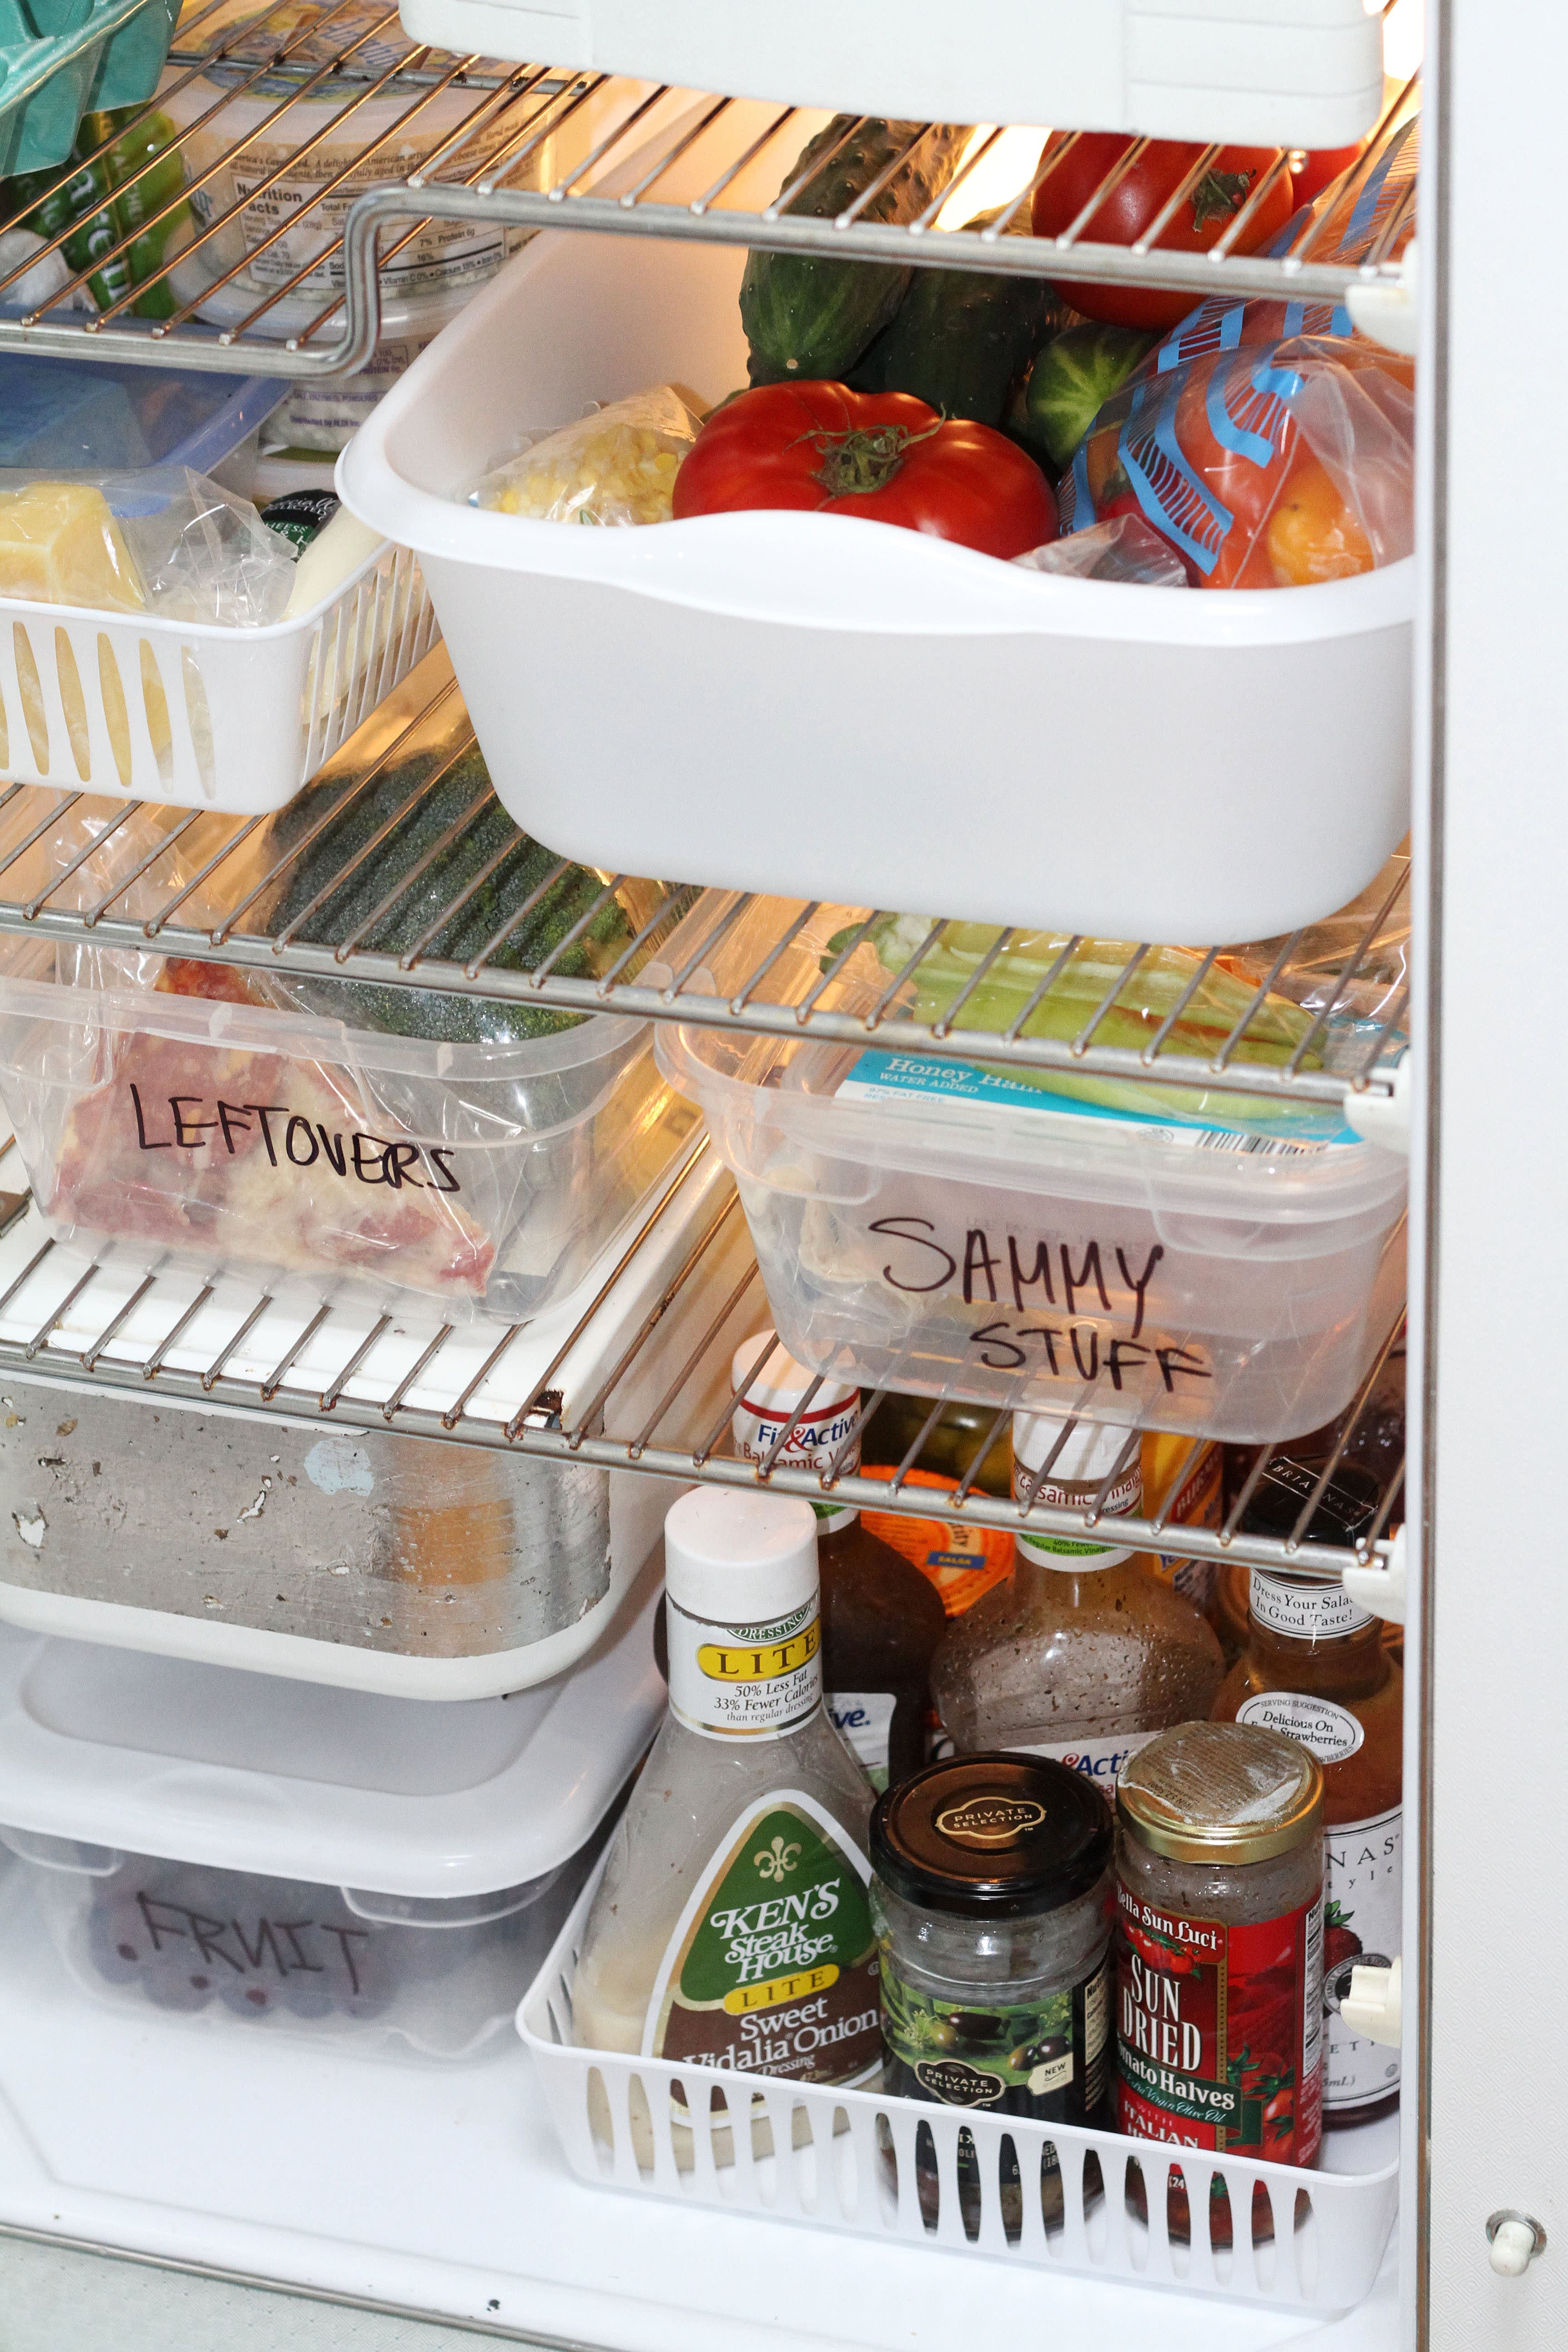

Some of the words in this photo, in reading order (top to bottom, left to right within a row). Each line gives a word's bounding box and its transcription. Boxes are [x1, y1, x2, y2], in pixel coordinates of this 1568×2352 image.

[247, 202, 279, 215] acts
[880, 1072, 926, 1086] WATER
[929, 1079, 979, 1094] ADDED
[885, 1058, 973, 1083] Honey
[130, 1083, 461, 1192] LEFTOVERS
[868, 1217, 1164, 1338] SAMMY
[969, 1322, 1212, 1392] STUFF
[1102, 1498, 1129, 1514] ressing
[1253, 1577, 1282, 1604] Dress
[1284, 1594, 1317, 1610] Your
[1321, 1595, 1353, 1609] Sala
[738, 1611, 804, 1640] DRESSING
[1256, 1596, 1265, 1613] In
[1269, 1606, 1305, 1626] Good
[1309, 1608, 1352, 1626] Taste!
[716, 1628, 816, 1675] LITE
[734, 1685, 762, 1697] 50%
[766, 1680, 789, 1695] Less
[792, 1668, 808, 1686] Fat
[714, 1696, 740, 1711] 33%
[745, 1697, 781, 1711] Fewer
[726, 1712, 748, 1721] than
[751, 1709, 784, 1723] regular
[785, 1694, 813, 1714] dressing
[1260, 1699, 1291, 1708] SERVING
[1292, 1700, 1339, 1720] SUGGESTION
[1262, 1710, 1313, 1730] Delicious
[1315, 1720, 1333, 1733] On
[1280, 1727, 1348, 1746] Strawberries
[953, 1814, 1033, 1828] SELECTION
[954, 1807, 1026, 1822] PRIVATE
[710, 1878, 841, 1940] KEN'S
[137, 1890, 370, 1995] FRUIT
[725, 1921, 810, 1964] Steak
[1142, 1906, 1174, 1936] Sun
[1175, 1921, 1217, 1950] Luci
[735, 1934, 834, 1983] House
[742, 1970, 825, 2008] LITE
[1131, 1954, 1181, 2022] SUN
[740, 1997, 828, 2042] Sweet
[793, 2009, 879, 2053] Onion
[1123, 1985, 1201, 2071] DRIED
[762, 2054, 815, 2076] Dressing
[926, 2069, 989, 2087] PRIVATE
[1044, 2062, 1068, 2077] NEW
[924, 2076, 993, 2095] SELECTION
[1159, 2068, 1235, 2111] Halves
[1147, 2086, 1176, 2110] Virgin
[1176, 2101, 1205, 2119] Olive
[1204, 2108, 1227, 2123] Oil
[1124, 2099, 1199, 2149] ITALIAN
